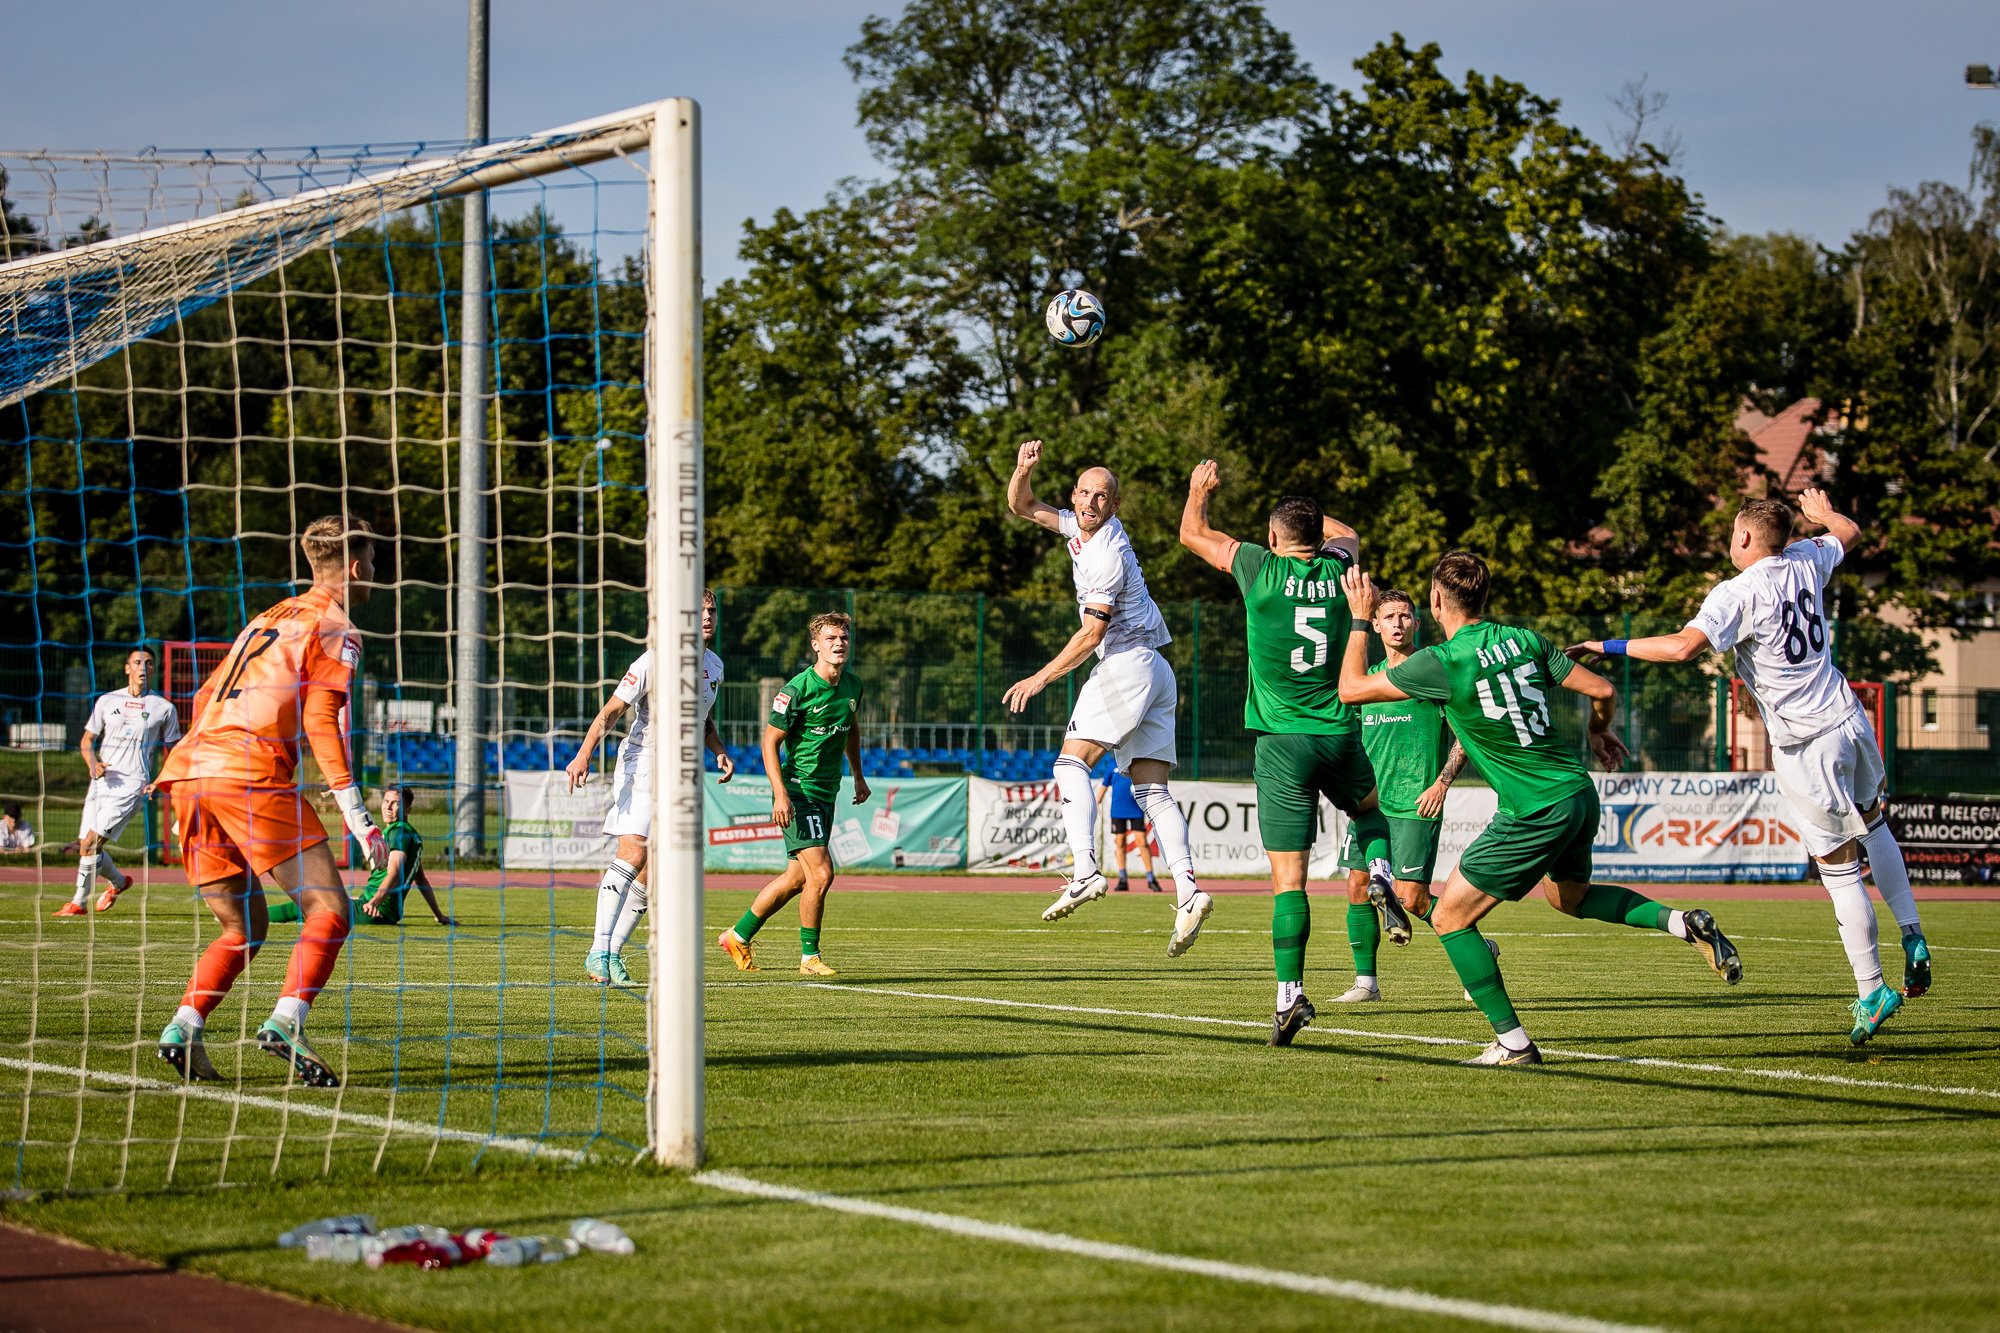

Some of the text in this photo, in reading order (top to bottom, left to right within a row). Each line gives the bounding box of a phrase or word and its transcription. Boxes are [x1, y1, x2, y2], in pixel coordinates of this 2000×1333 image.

[679, 462, 698, 570] SPORT
[1781, 587, 1825, 665] 88
[1290, 606, 1328, 674] 5
[215, 628, 280, 702] 12
[680, 610, 698, 785] TRANSFER
[1475, 660, 1550, 748] 45
[1377, 713, 1413, 726] Nawrot
[1670, 777, 1781, 797] ZAOPATRU
[1706, 802, 1778, 815] BUDOANY
[1889, 803, 2000, 824] PUNKT PIELĘGN
[806, 815, 824, 839] 13
[990, 826, 1068, 845] ZABOBRZ
[1443, 818, 1488, 834] Sprzed
[1905, 822, 2000, 841] SAMOCHODÓ
[1190, 843, 1265, 859] NETWO
